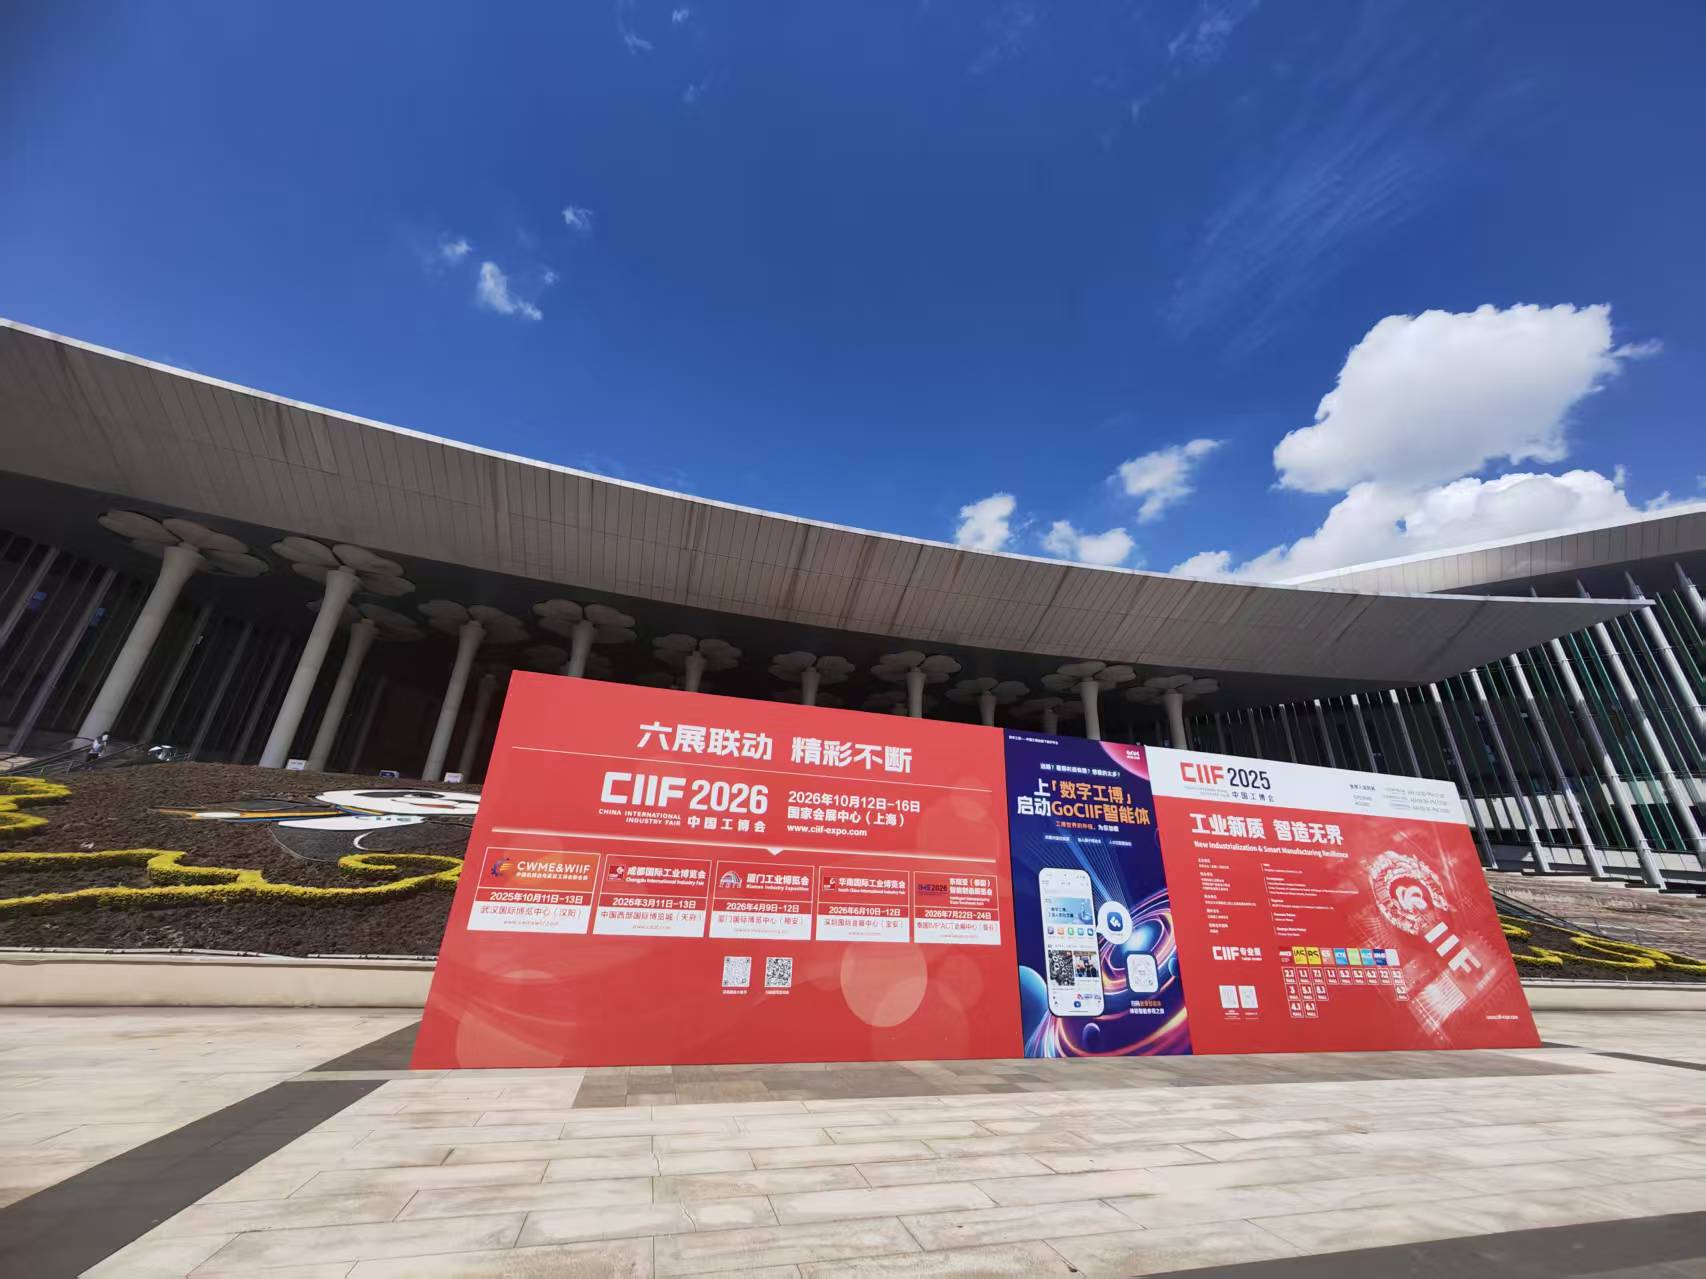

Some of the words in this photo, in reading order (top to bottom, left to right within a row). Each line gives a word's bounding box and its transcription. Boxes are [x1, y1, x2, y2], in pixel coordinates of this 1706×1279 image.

[636, 721, 773, 761] 六展联动
[790, 736, 912, 774] 精彩不断
[1180, 761, 1224, 785] CIIF
[1227, 767, 1271, 790] 2025
[600, 771, 687, 807] CIIF
[689, 779, 769, 815] 2026
[1231, 791, 1275, 802] 中国工博会
[788, 790, 920, 813] 2026年10月12日-16日
[598, 808, 621, 816] CHINA
[624, 810, 681, 820] INTERNATIONAL
[787, 806, 905, 827] 国家会展中心（上海）
[1017, 795, 1150, 825] 启动GoCIIF智能体
[626, 817, 662, 825] INDUSTRY
[664, 818, 681, 826] FAIR
[687, 815, 767, 833] 中国工博会
[787, 824, 867, 837] www.ciif-expo.com
[1189, 812, 1267, 839] 工业新质
[1272, 819, 1344, 846] 智造无界
[1193, 840, 1208, 848] New
[1209, 841, 1257, 852] Industrialization
[1263, 846, 1281, 854] Smart
[517, 860, 591, 875] CWME&WIIF
[626, 866, 706, 880] 成都国际工业博览会
[746, 873, 809, 886] 厦门工业博览会
[490, 891, 583, 904] 2025年10月11日-13日
[612, 897, 697, 909] 2026年3月11日-13日
[726, 902, 800, 913] 2026年4月9日-12日
[829, 906, 900, 916] 2026年6月10日-12日
[925, 910, 992, 920] 2026年7月22日-24日
[1212, 946, 1239, 960] CIIF
